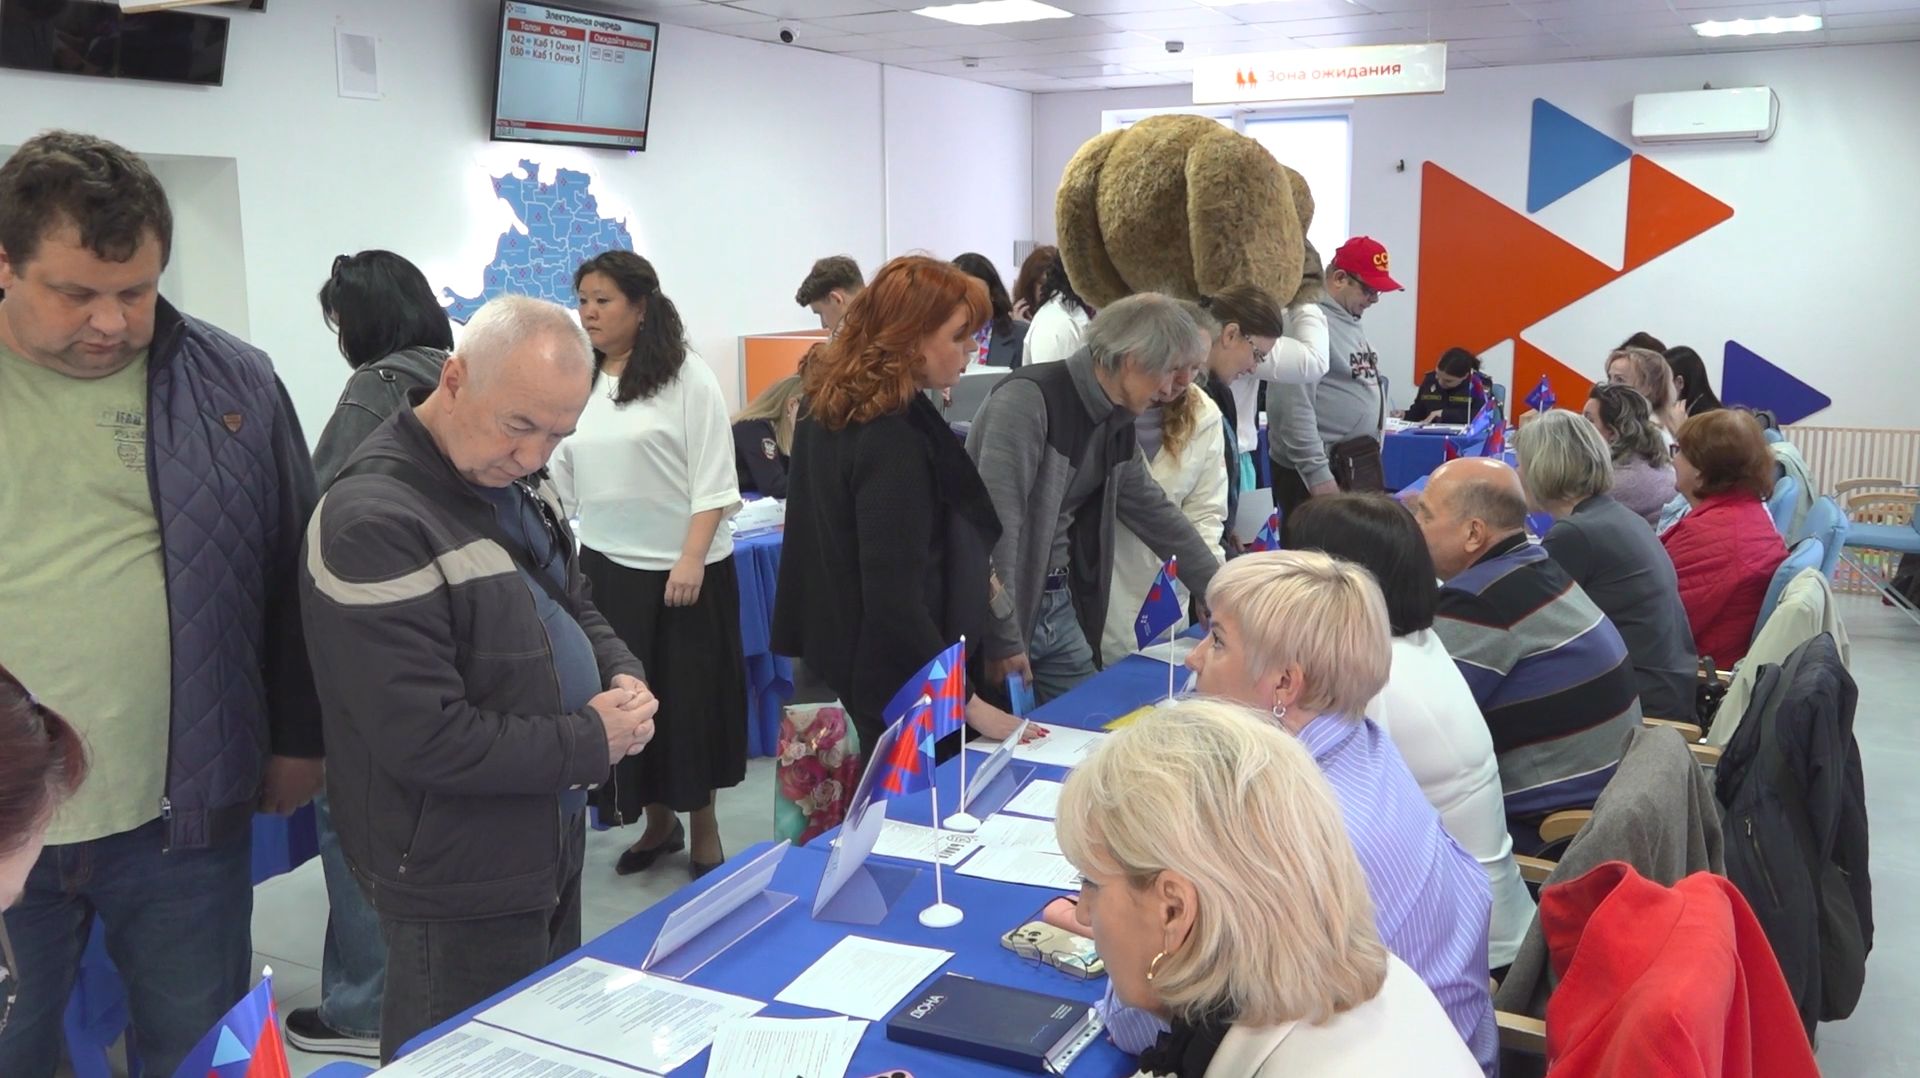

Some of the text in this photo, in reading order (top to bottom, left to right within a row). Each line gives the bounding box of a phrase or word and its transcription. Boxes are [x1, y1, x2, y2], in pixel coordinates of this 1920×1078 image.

[520, 22, 567, 36] Талон Окно
[545, 10, 622, 31] Электронная очередь
[511, 34, 524, 44] 042
[533, 37, 548, 48] Каб
[555, 41, 576, 51] Окно
[594, 33, 625, 46] Ожидайте
[510, 46, 524, 56] 030
[533, 49, 547, 59] Каб
[554, 53, 574, 64] Окно
[1267, 63, 1402, 82] Зона ожидания
